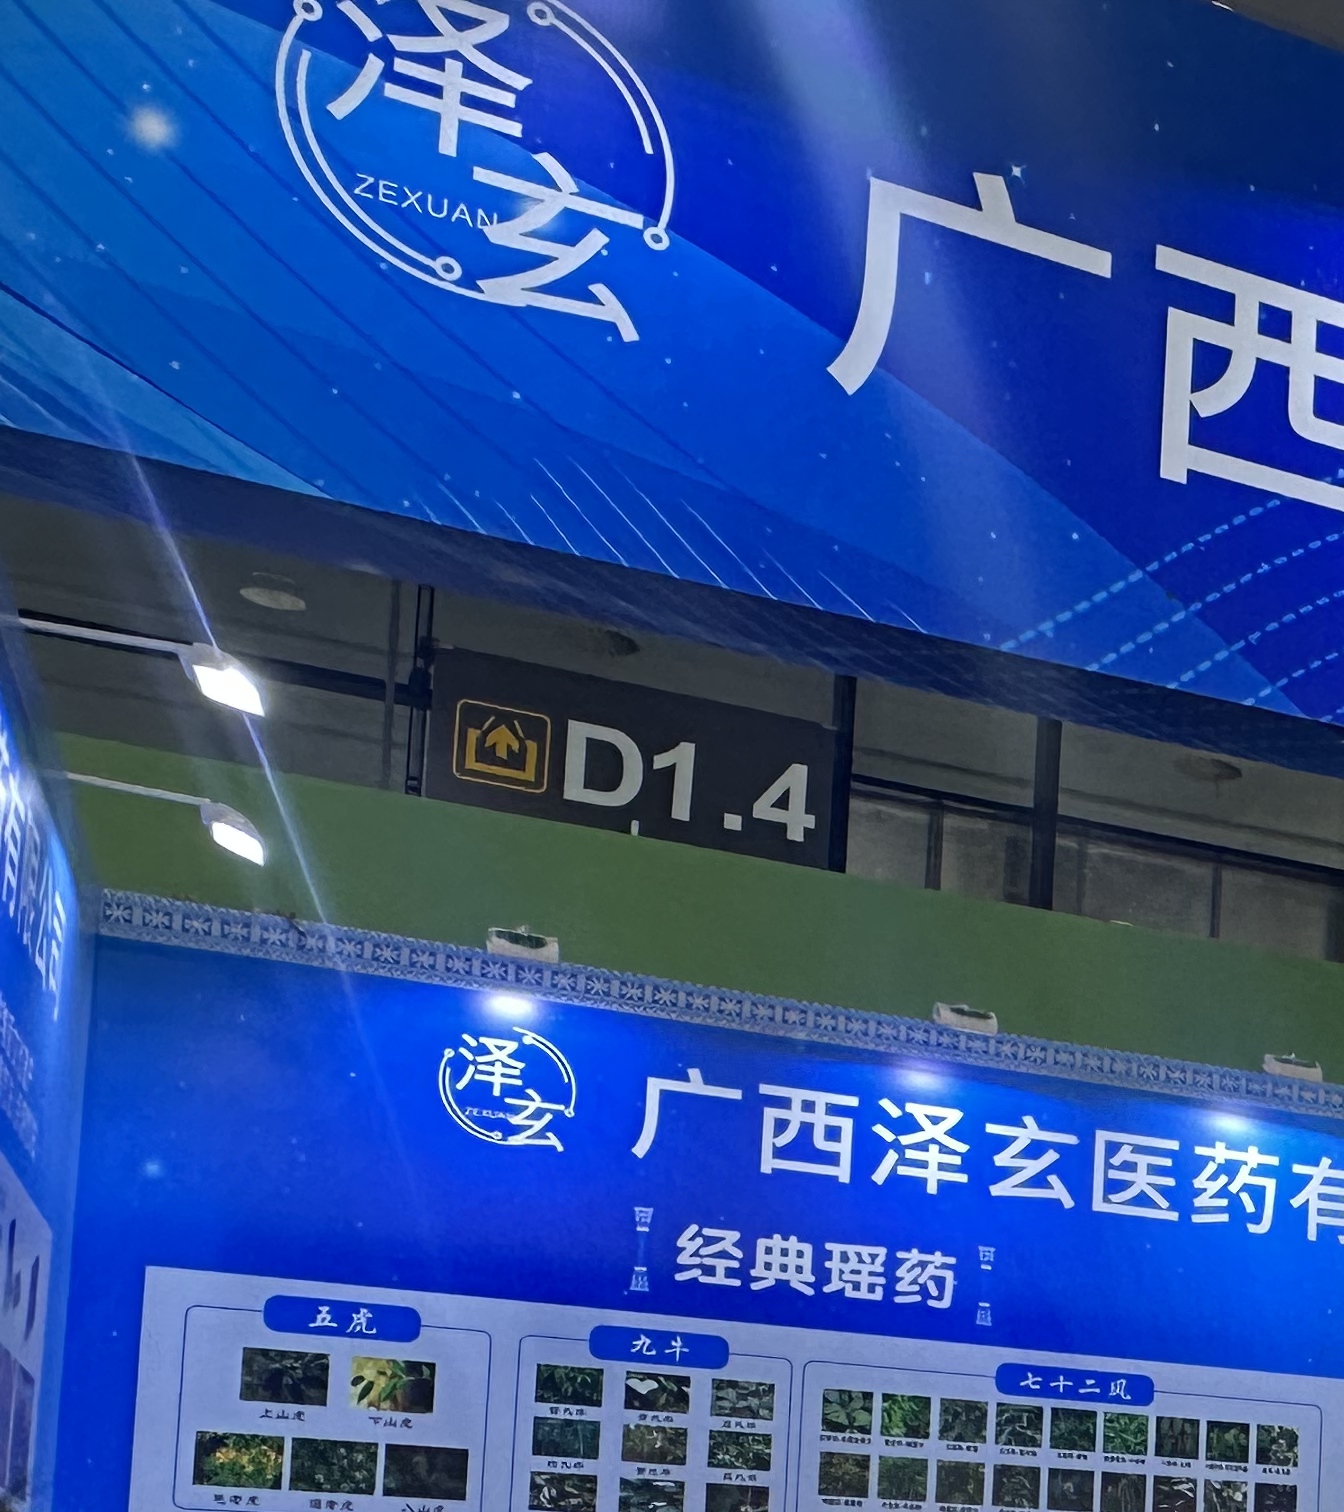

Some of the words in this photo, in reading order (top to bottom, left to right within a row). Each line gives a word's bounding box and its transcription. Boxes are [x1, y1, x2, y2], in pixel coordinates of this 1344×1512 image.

[325, 0, 645, 342] 泽玄
[354, 172, 500, 232] ZEXUAN
[563, 718, 816, 843] D1.4
[455, 1031, 565, 1153] 泽玄
[673, 1222, 958, 1311] 经典瑶药
[630, 1333, 690, 1363] 九牛
